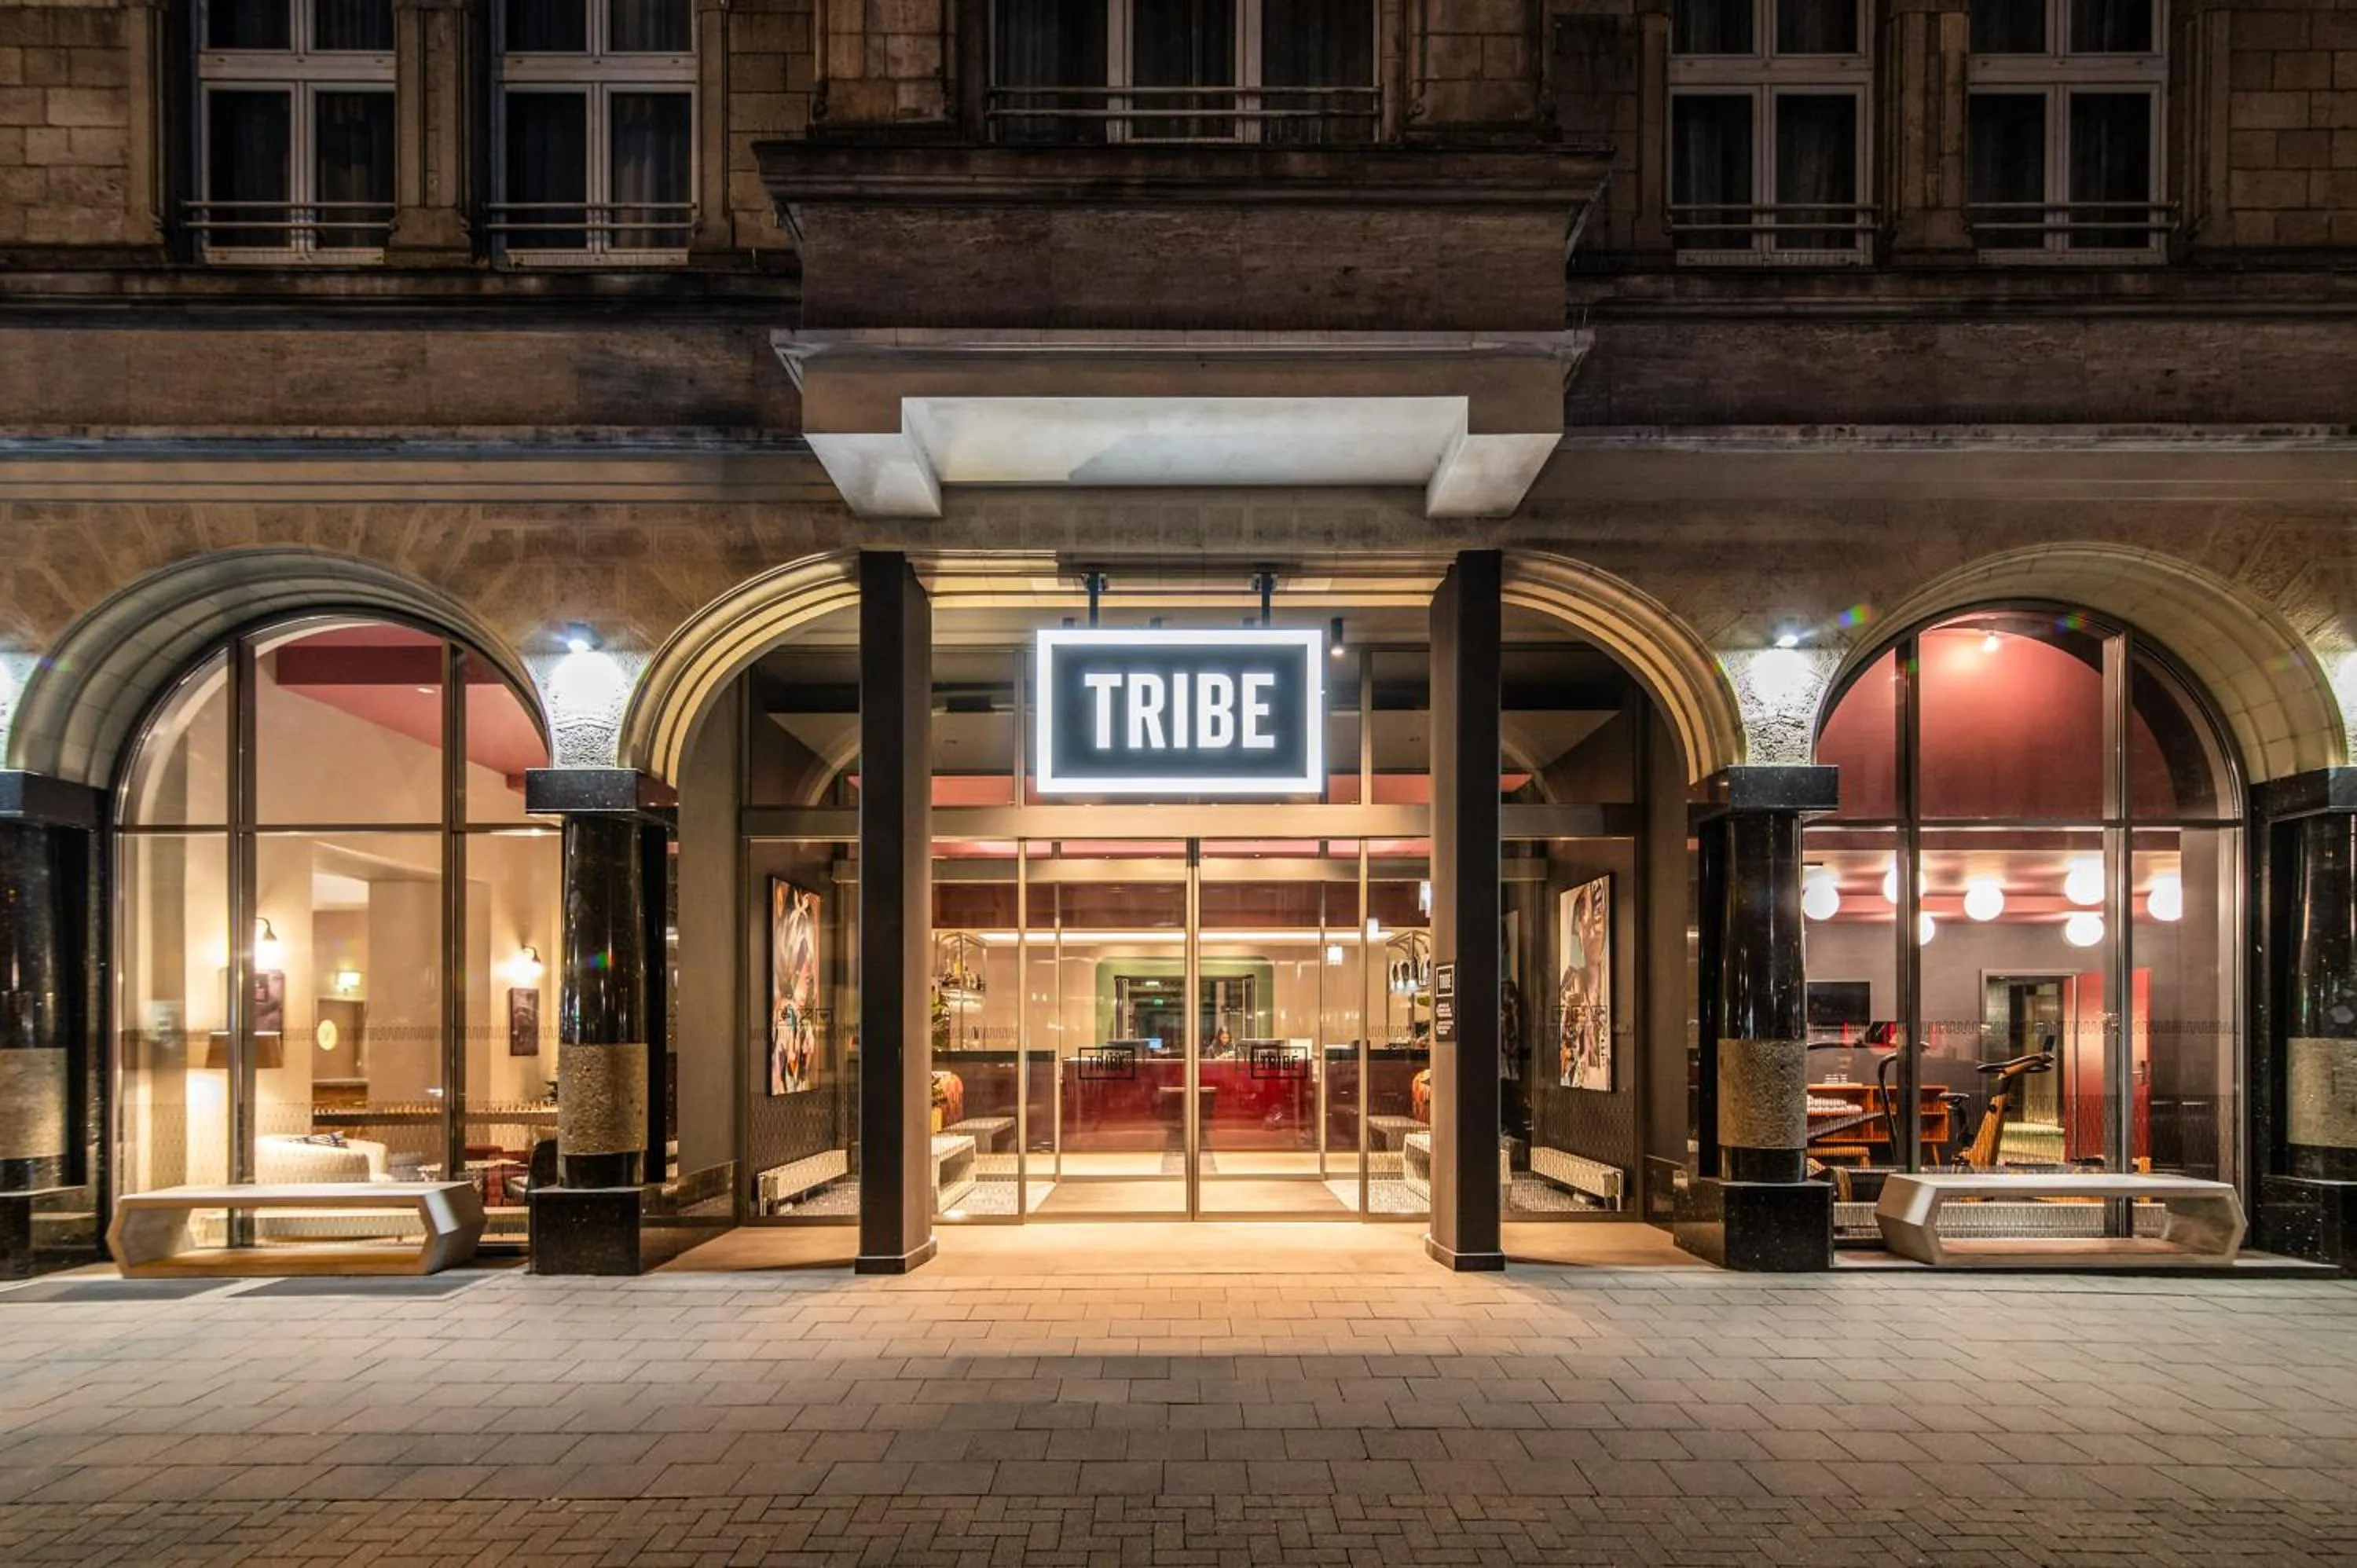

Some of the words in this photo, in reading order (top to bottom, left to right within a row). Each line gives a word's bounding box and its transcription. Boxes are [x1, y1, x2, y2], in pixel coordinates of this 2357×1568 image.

[1083, 673, 1276, 749] TRIBE
[1087, 1055, 1126, 1071] TRIBE
[1260, 1055, 1299, 1071] TRIBE
